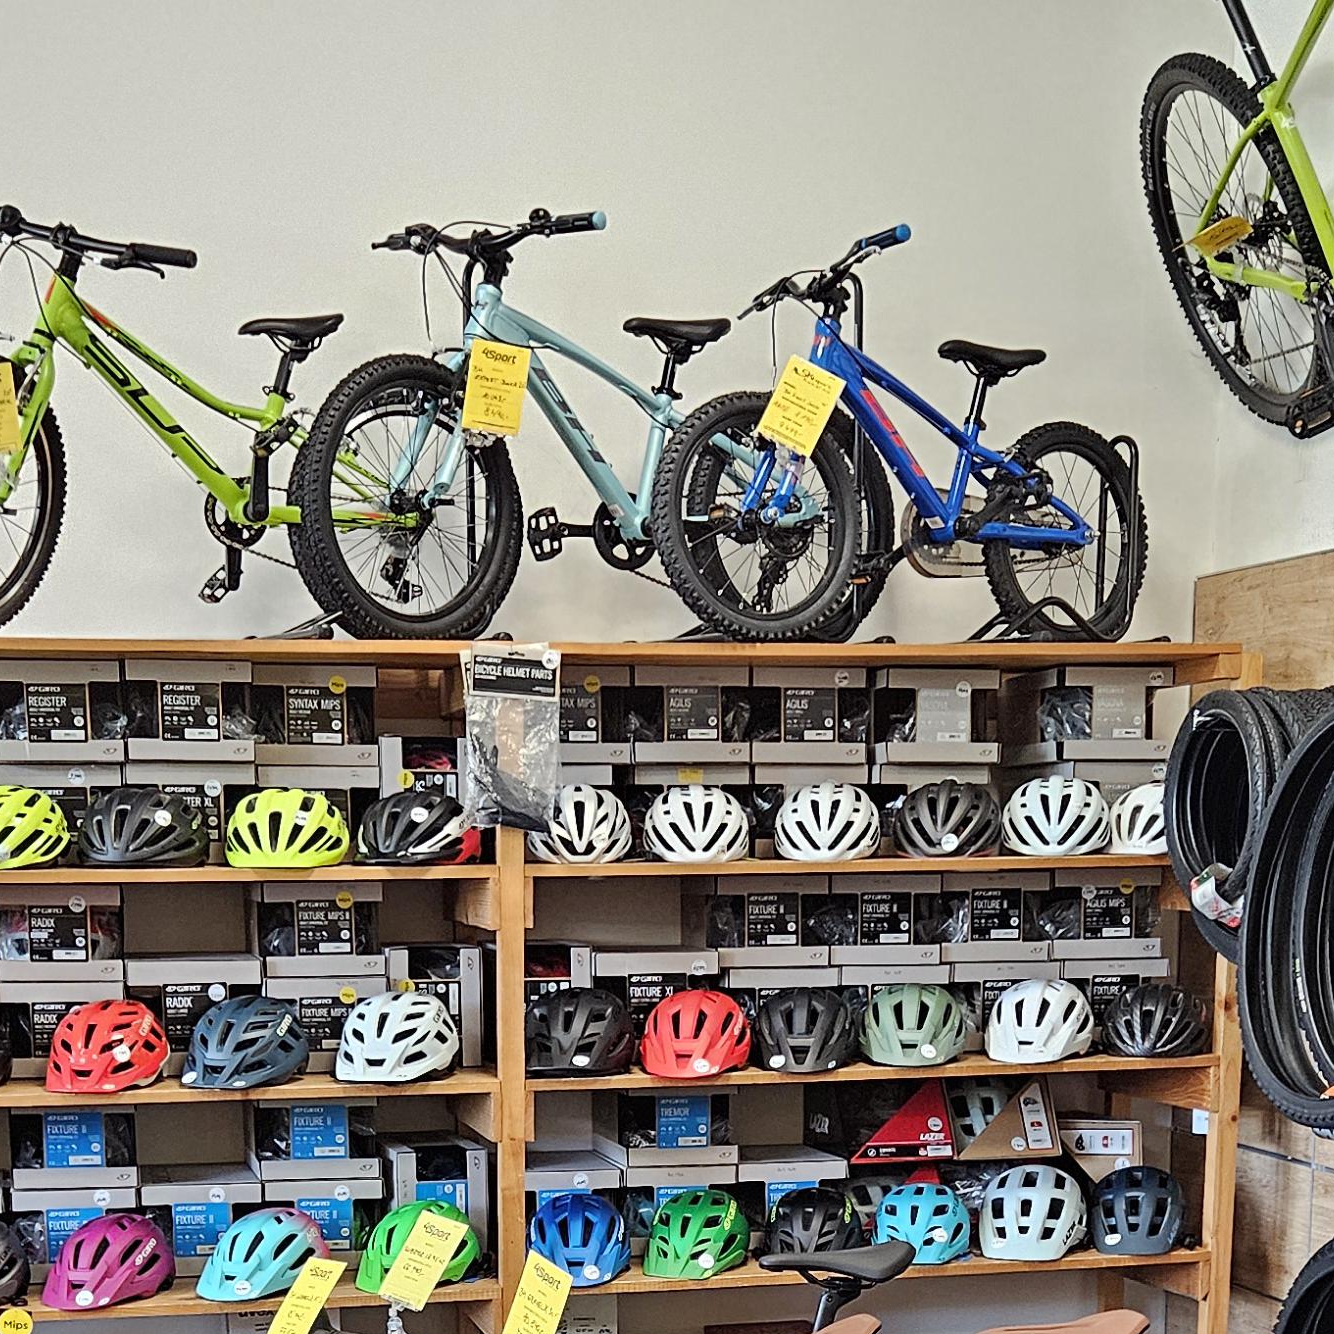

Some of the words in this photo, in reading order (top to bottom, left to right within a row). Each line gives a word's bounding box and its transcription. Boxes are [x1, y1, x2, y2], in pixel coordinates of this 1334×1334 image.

[1145, 102, 1158, 191] SCHWALBE
[482, 347, 517, 364] 4Sport
[474, 664, 502, 676] BICYCLE
[502, 666, 530, 679] HELMET
[531, 668, 553, 681] PARTS
[28, 696, 67, 706] REGISTER
[163, 694, 201, 706] REGISTER
[288, 698, 318, 710] SYNTAX
[320, 699, 341, 710] MIPS
[785, 698, 808, 710] AGILIS
[204, 797, 215, 807] XL
[748, 904, 778, 914] FIXTURE
[862, 903, 890, 913] FIXTURE
[973, 900, 1001, 910] FIXTURE
[1108, 899, 1126, 908] MIPS
[298, 911, 326, 921] FIXTURE
[327, 911, 344, 921] MIPS
[31, 917, 55, 928] RADIX
[629, 986, 662, 998] FIXTURE
[1093, 985, 1120, 995] FIXTURE
[166, 996, 194, 1008] RADIX
[301, 1007, 329, 1017] FIXTURE
[330, 1007, 347, 1017] MIPS
[34, 1013, 58, 1024] RADIX
[277, 1013, 293, 1037] GIRO
[660, 1107, 690, 1117] TREMOR
[294, 1116, 325, 1126] FIXTURE
[47, 1124, 79, 1134] FIXTURE
[919, 1132, 945, 1141] LAZER
[48, 1220, 80, 1230] FIXTURE
[175, 1214, 206, 1225] FIXTURE
[423, 1222, 451, 1240] 4Sport
[141, 1237, 157, 1259] GIRO
[533, 1262, 561, 1290] 4Sport
[3, 1320, 28, 1331] Mips
